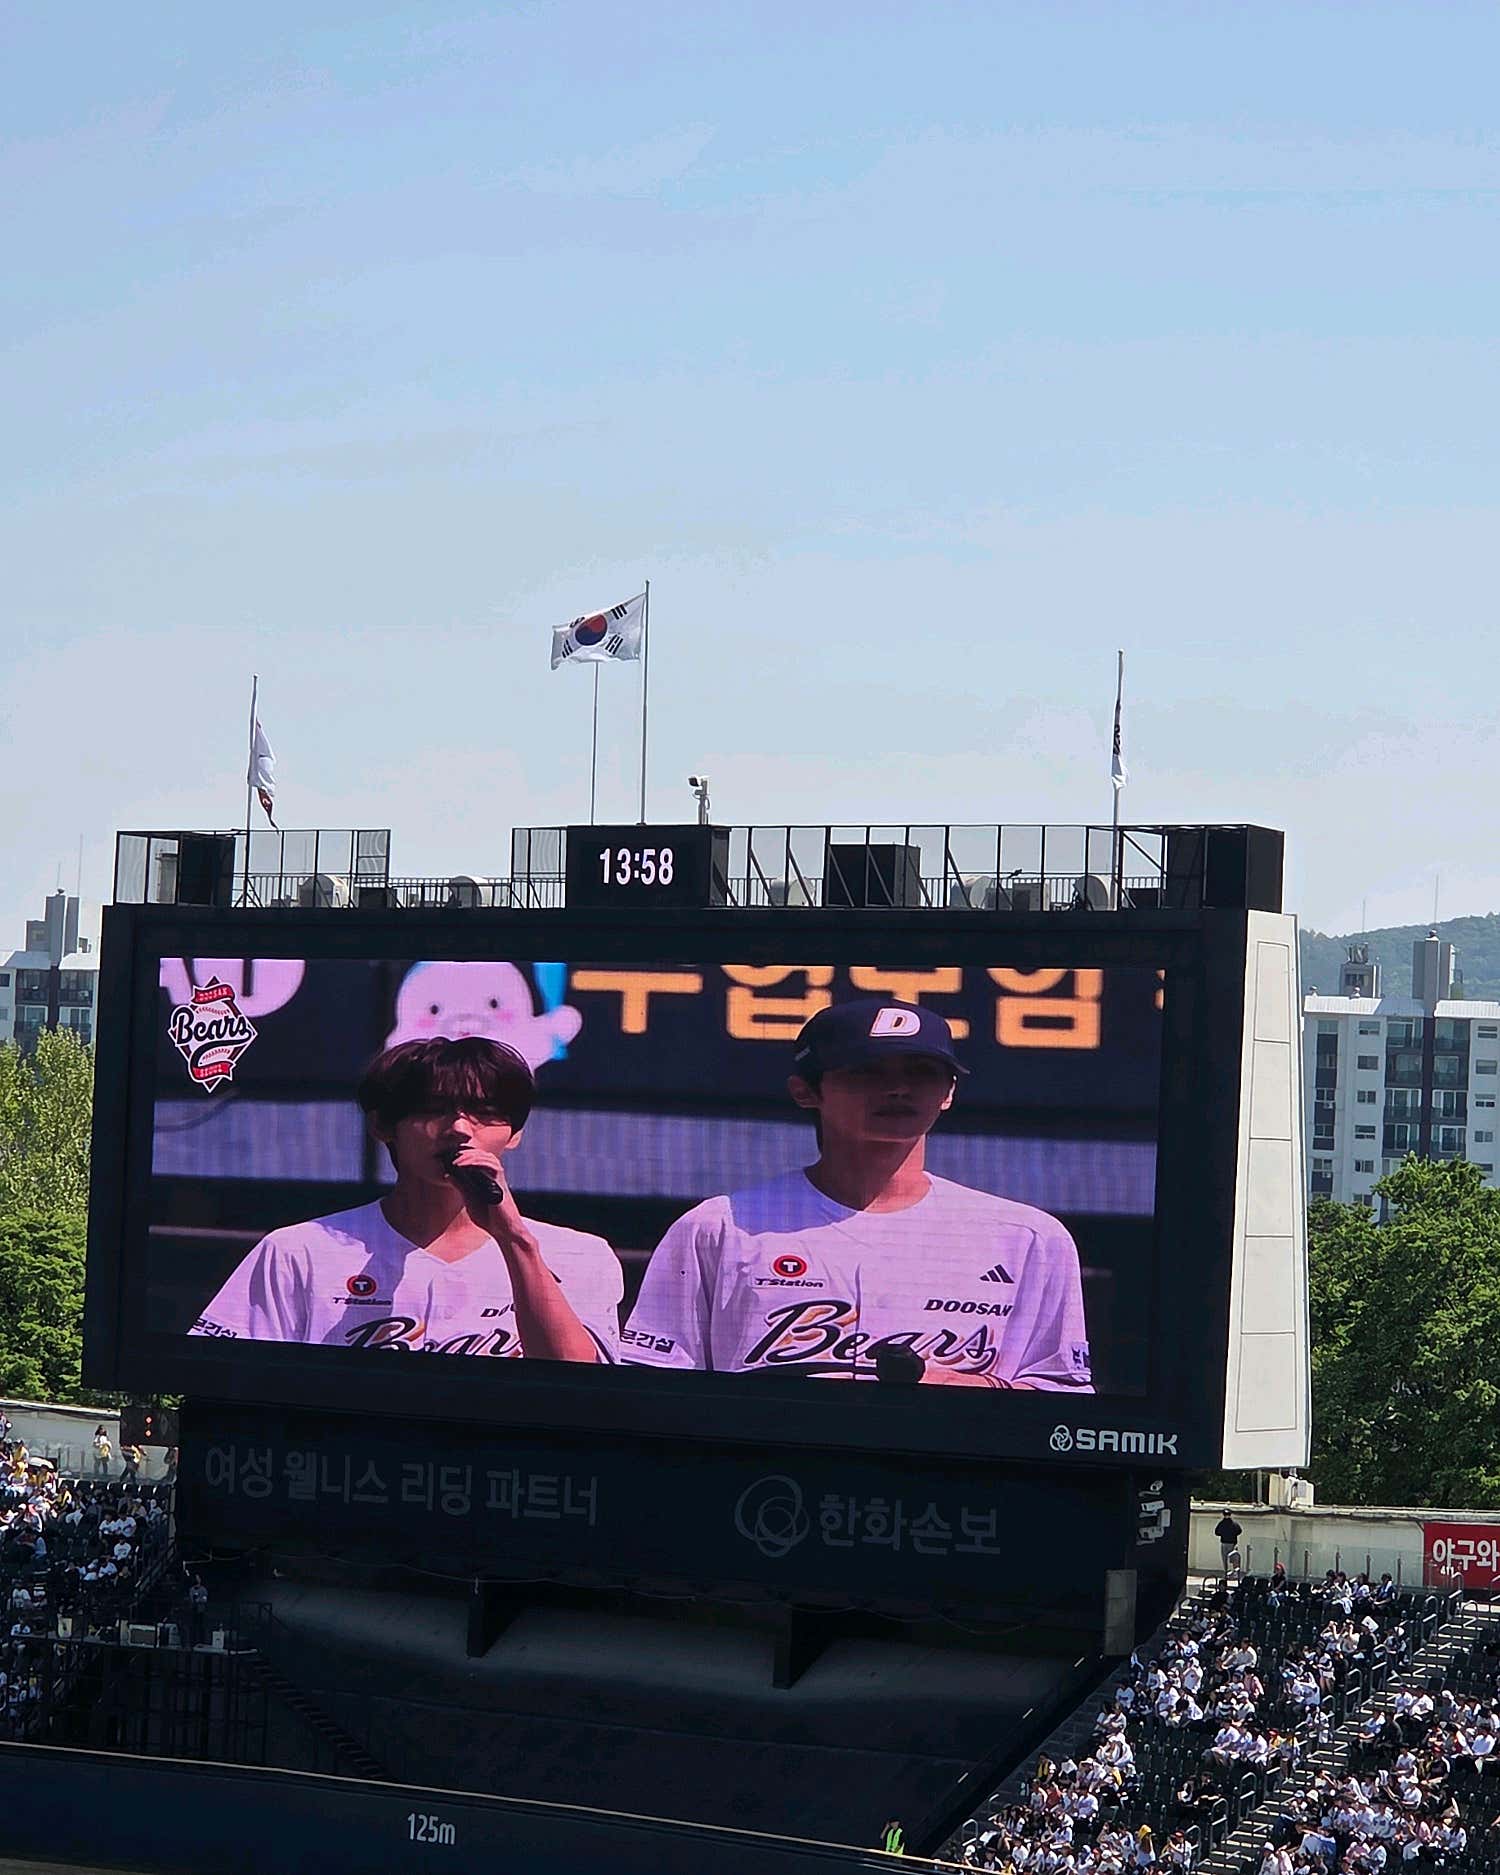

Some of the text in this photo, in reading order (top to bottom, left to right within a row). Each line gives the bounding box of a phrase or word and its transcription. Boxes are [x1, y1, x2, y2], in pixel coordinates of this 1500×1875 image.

[599, 848, 674, 885] 13:58
[170, 1006, 252, 1046] Bears
[870, 1007, 921, 1037] D
[1076, 1428, 1178, 1455] SAMIK
[205, 1445, 599, 1527] 여성 웰니스 리딩 파트너
[814, 1494, 1002, 1556] 한화손보
[1433, 1538, 1500, 1573] 야구와
[407, 1813, 456, 1845] 125m
